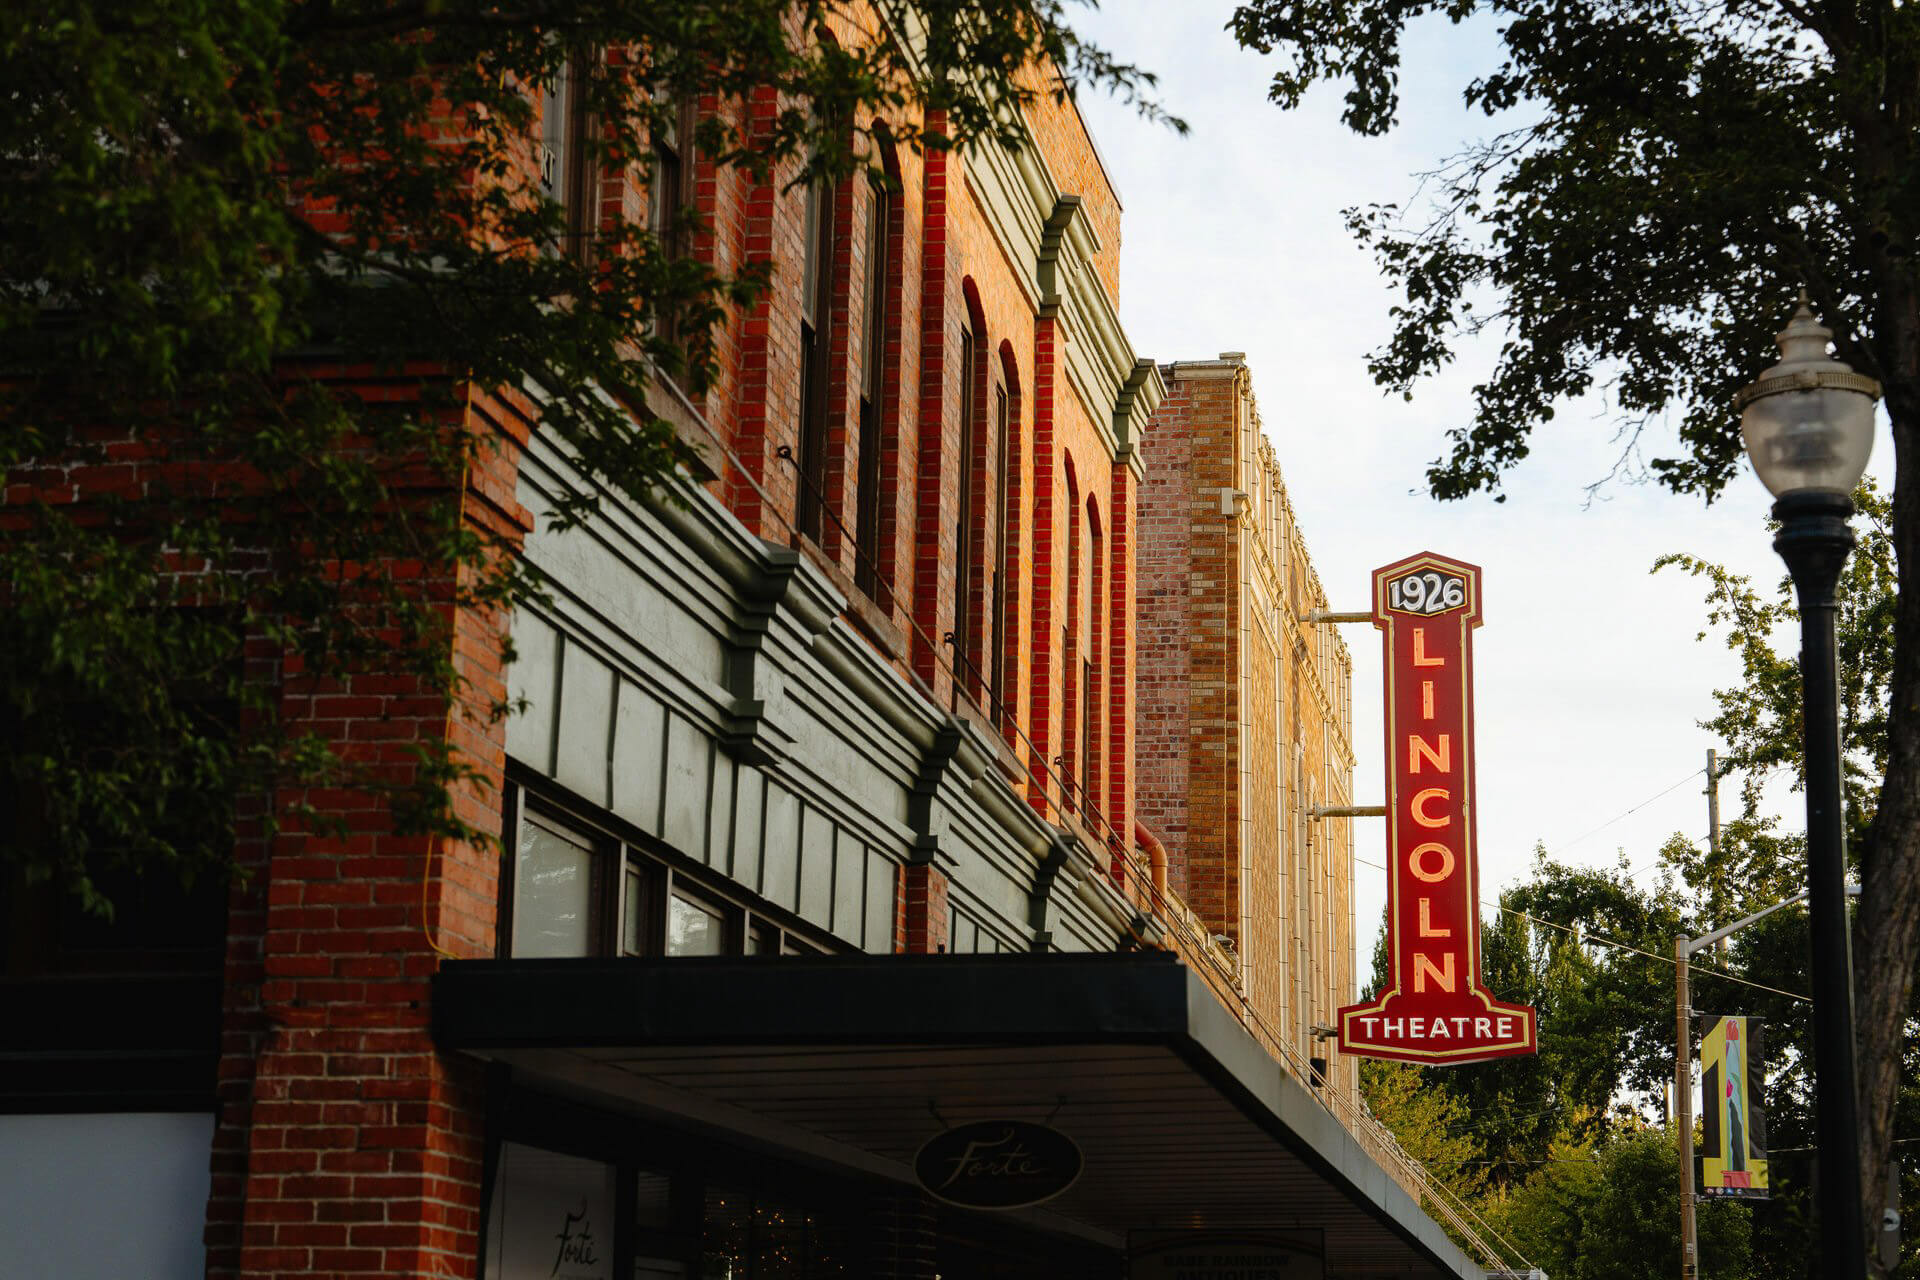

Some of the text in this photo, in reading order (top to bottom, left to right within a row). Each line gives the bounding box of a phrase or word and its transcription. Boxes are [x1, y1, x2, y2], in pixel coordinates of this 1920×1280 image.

[1390, 572, 1463, 614] 1926
[1408, 627, 1455, 993] LINCOLN
[1360, 1017, 1513, 1039] THEATRE
